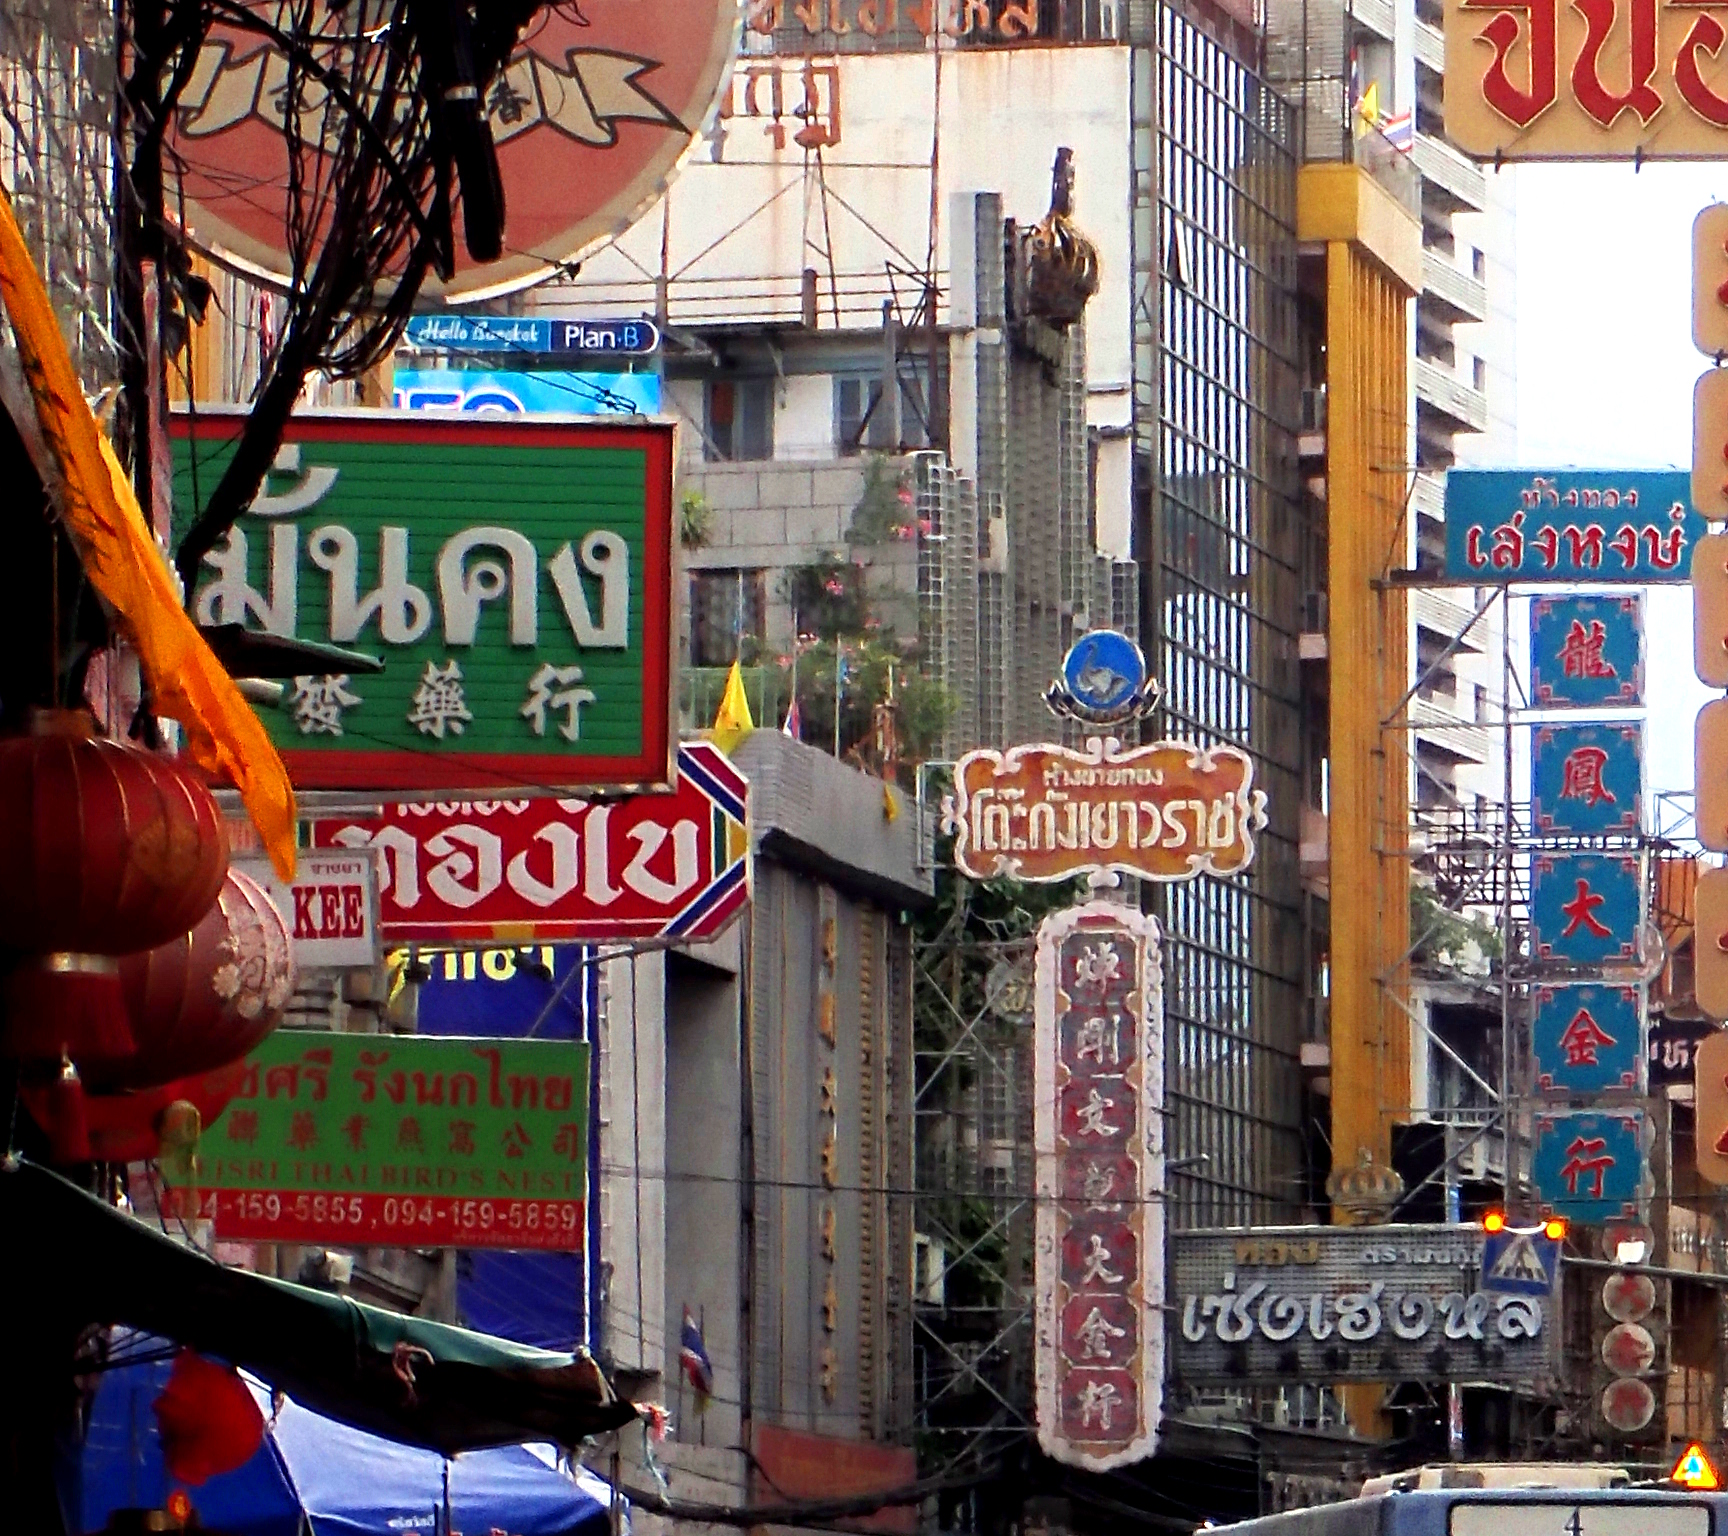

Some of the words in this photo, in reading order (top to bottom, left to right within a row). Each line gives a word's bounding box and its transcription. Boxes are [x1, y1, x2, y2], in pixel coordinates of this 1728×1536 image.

[418, 319, 467, 342] Hello
[1521, 479, 1639, 508] ห้างทอง
[290, 884, 365, 940] KEE
[294, 1161, 368, 1186] THAI
[382, 1164, 486, 1191] BIRD'S
[500, 1167, 578, 1194] NEST
[1182, 1271, 1543, 1343] เซ่งเฮงหล
